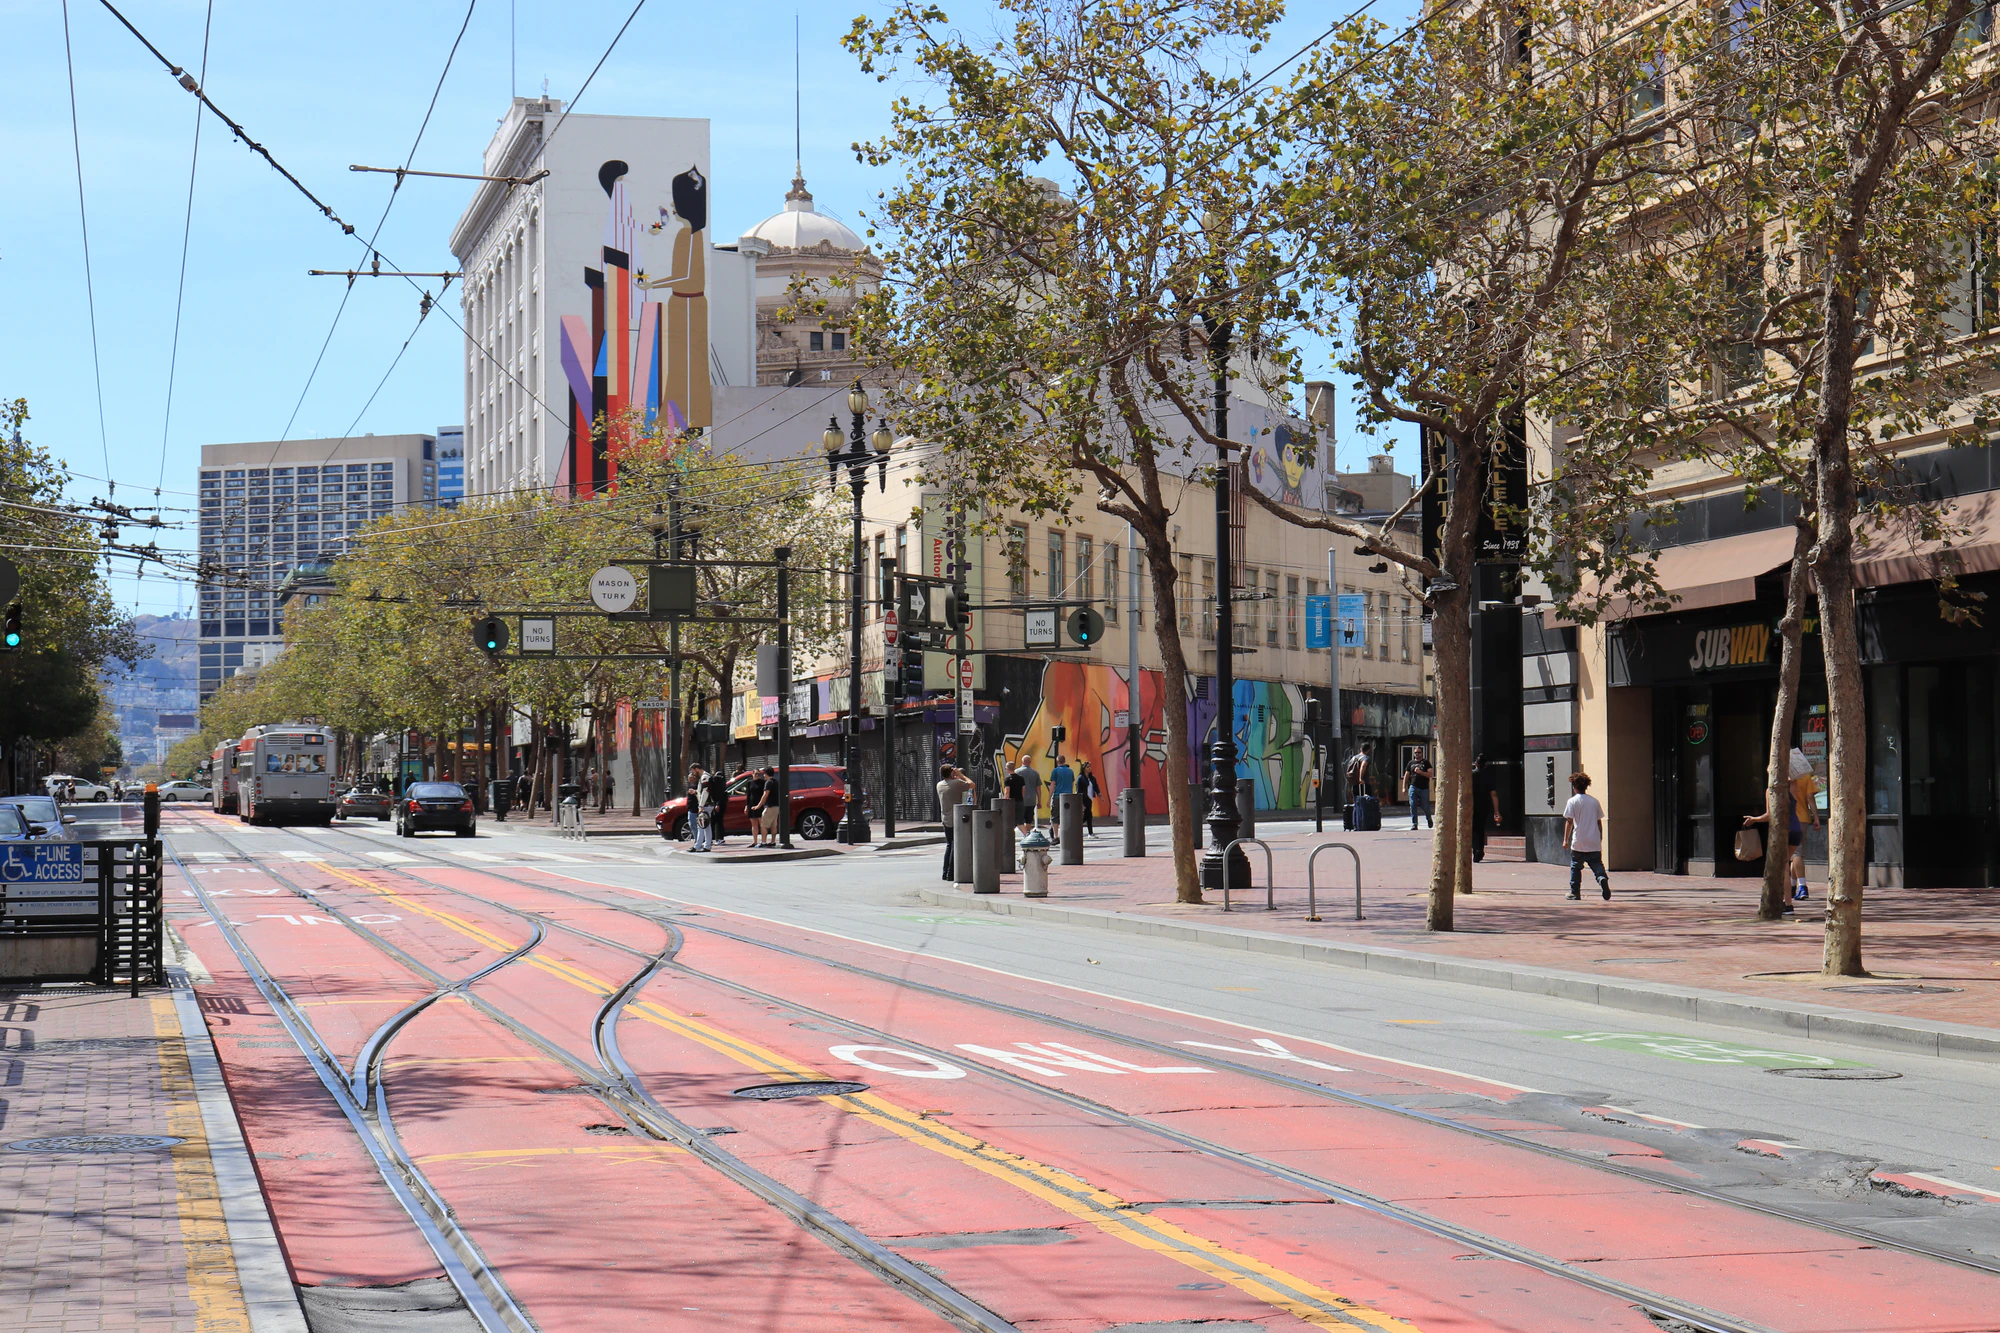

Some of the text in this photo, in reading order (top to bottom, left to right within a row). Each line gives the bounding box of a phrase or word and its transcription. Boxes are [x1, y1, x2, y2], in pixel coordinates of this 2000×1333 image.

[1482, 540, 1520, 550] Since 1938
[602, 592, 626, 600] TURK
[1315, 602, 1323, 638] TENDERLOIN
[532, 627, 543, 635] NO
[1029, 628, 1053, 636] TURNS
[525, 635, 551, 643] TURNS
[1689, 624, 1769, 671] SUBWAY
[1807, 717, 1826, 733] OPE
[1689, 726, 1705, 739] OPEN
[34, 846, 70, 861] F-LINE
[35, 864, 80, 880] ACCESS
[196, 914, 402, 927] ONLY
[828, 1038, 1354, 1080] ONLY
